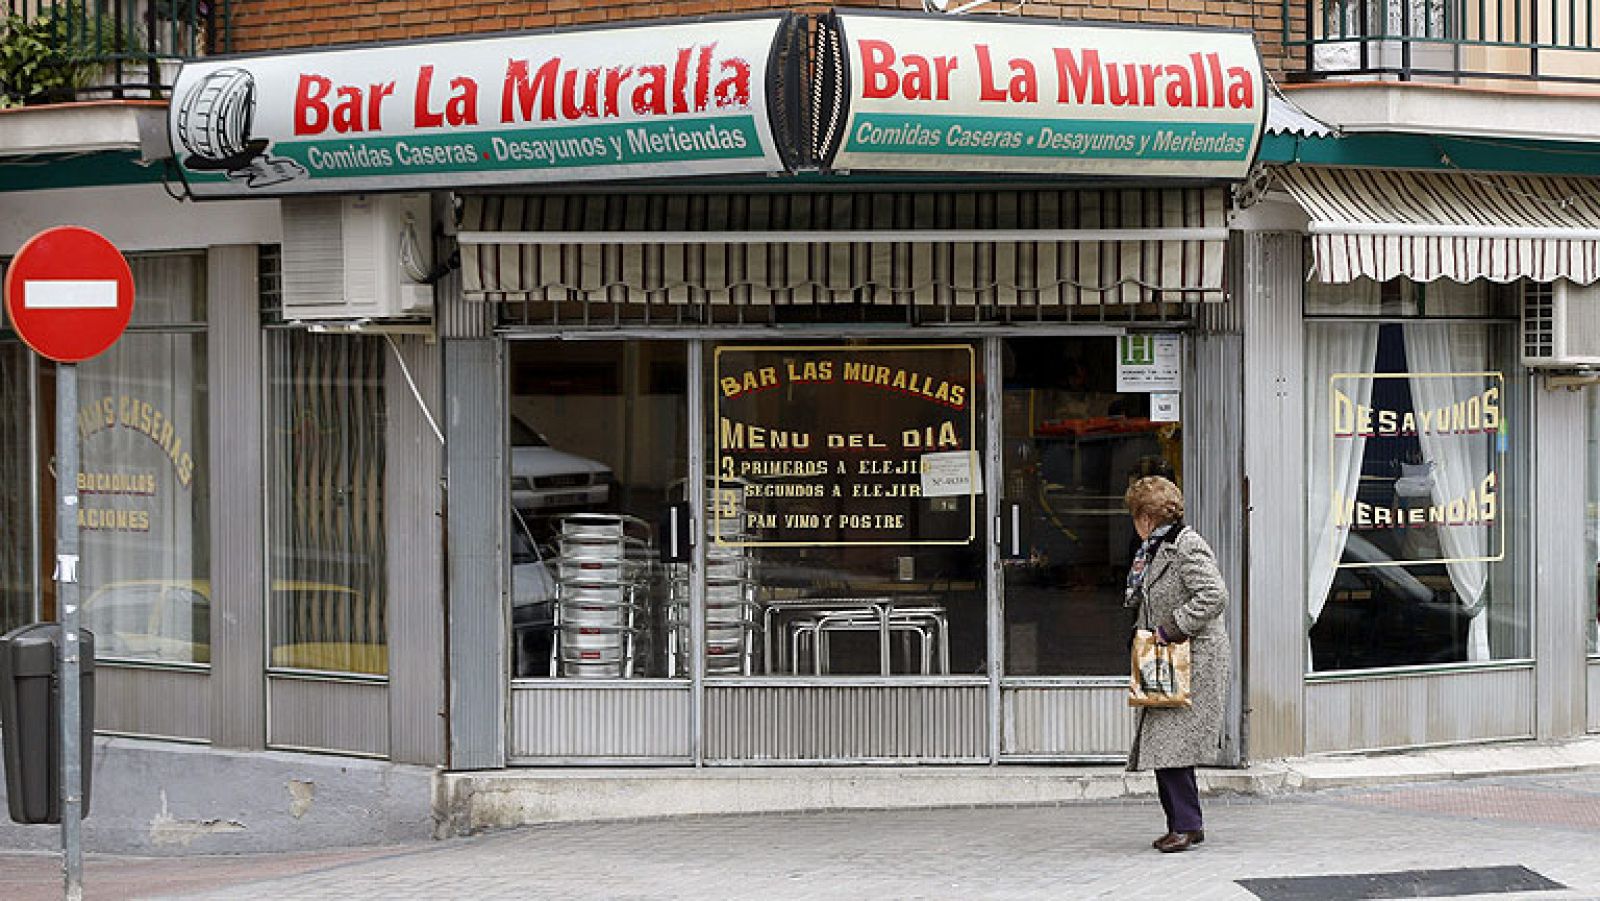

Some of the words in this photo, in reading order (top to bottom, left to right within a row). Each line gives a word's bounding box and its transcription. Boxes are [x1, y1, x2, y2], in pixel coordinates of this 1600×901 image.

[294, 73, 395, 136] Bar
[414, 64, 479, 130] La
[501, 43, 752, 123] Muralla
[857, 39, 958, 101] Bar
[974, 43, 1039, 103] La
[1052, 46, 1254, 110] Muralla
[307, 141, 394, 170] Comidas
[395, 140, 478, 167] Caseras
[493, 133, 606, 164] Desayunos
[609, 136, 623, 161] y
[627, 124, 747, 155] Meriendas
[856, 121, 941, 147] Comidas
[945, 125, 1022, 149] Caseras
[1037, 127, 1135, 155] Desayunos
[1139, 133, 1151, 156] y
[1152, 130, 1246, 154] Meriendas
[720, 366, 778, 399] BAR
[787, 361, 833, 382] LAS
[843, 362, 966, 407] MURALLAS
[1334, 386, 1499, 435] DESAYUNOS
[720, 416, 810, 450] MENU
[827, 433, 887, 448] DEL
[902, 420, 958, 448] DIA
[77, 472, 156, 492] BOCADILLOS
[722, 456, 735, 482] 3
[741, 460, 828, 475] PRIMEROS
[836, 460, 847, 475] A
[745, 484, 824, 497] SEGUNDOS
[831, 484, 842, 497] A
[852, 484, 922, 497] ELEJIR
[1334, 470, 1498, 526] MERIENDAS
[77, 507, 150, 530] ACIONES
[747, 514, 777, 529] PAN
